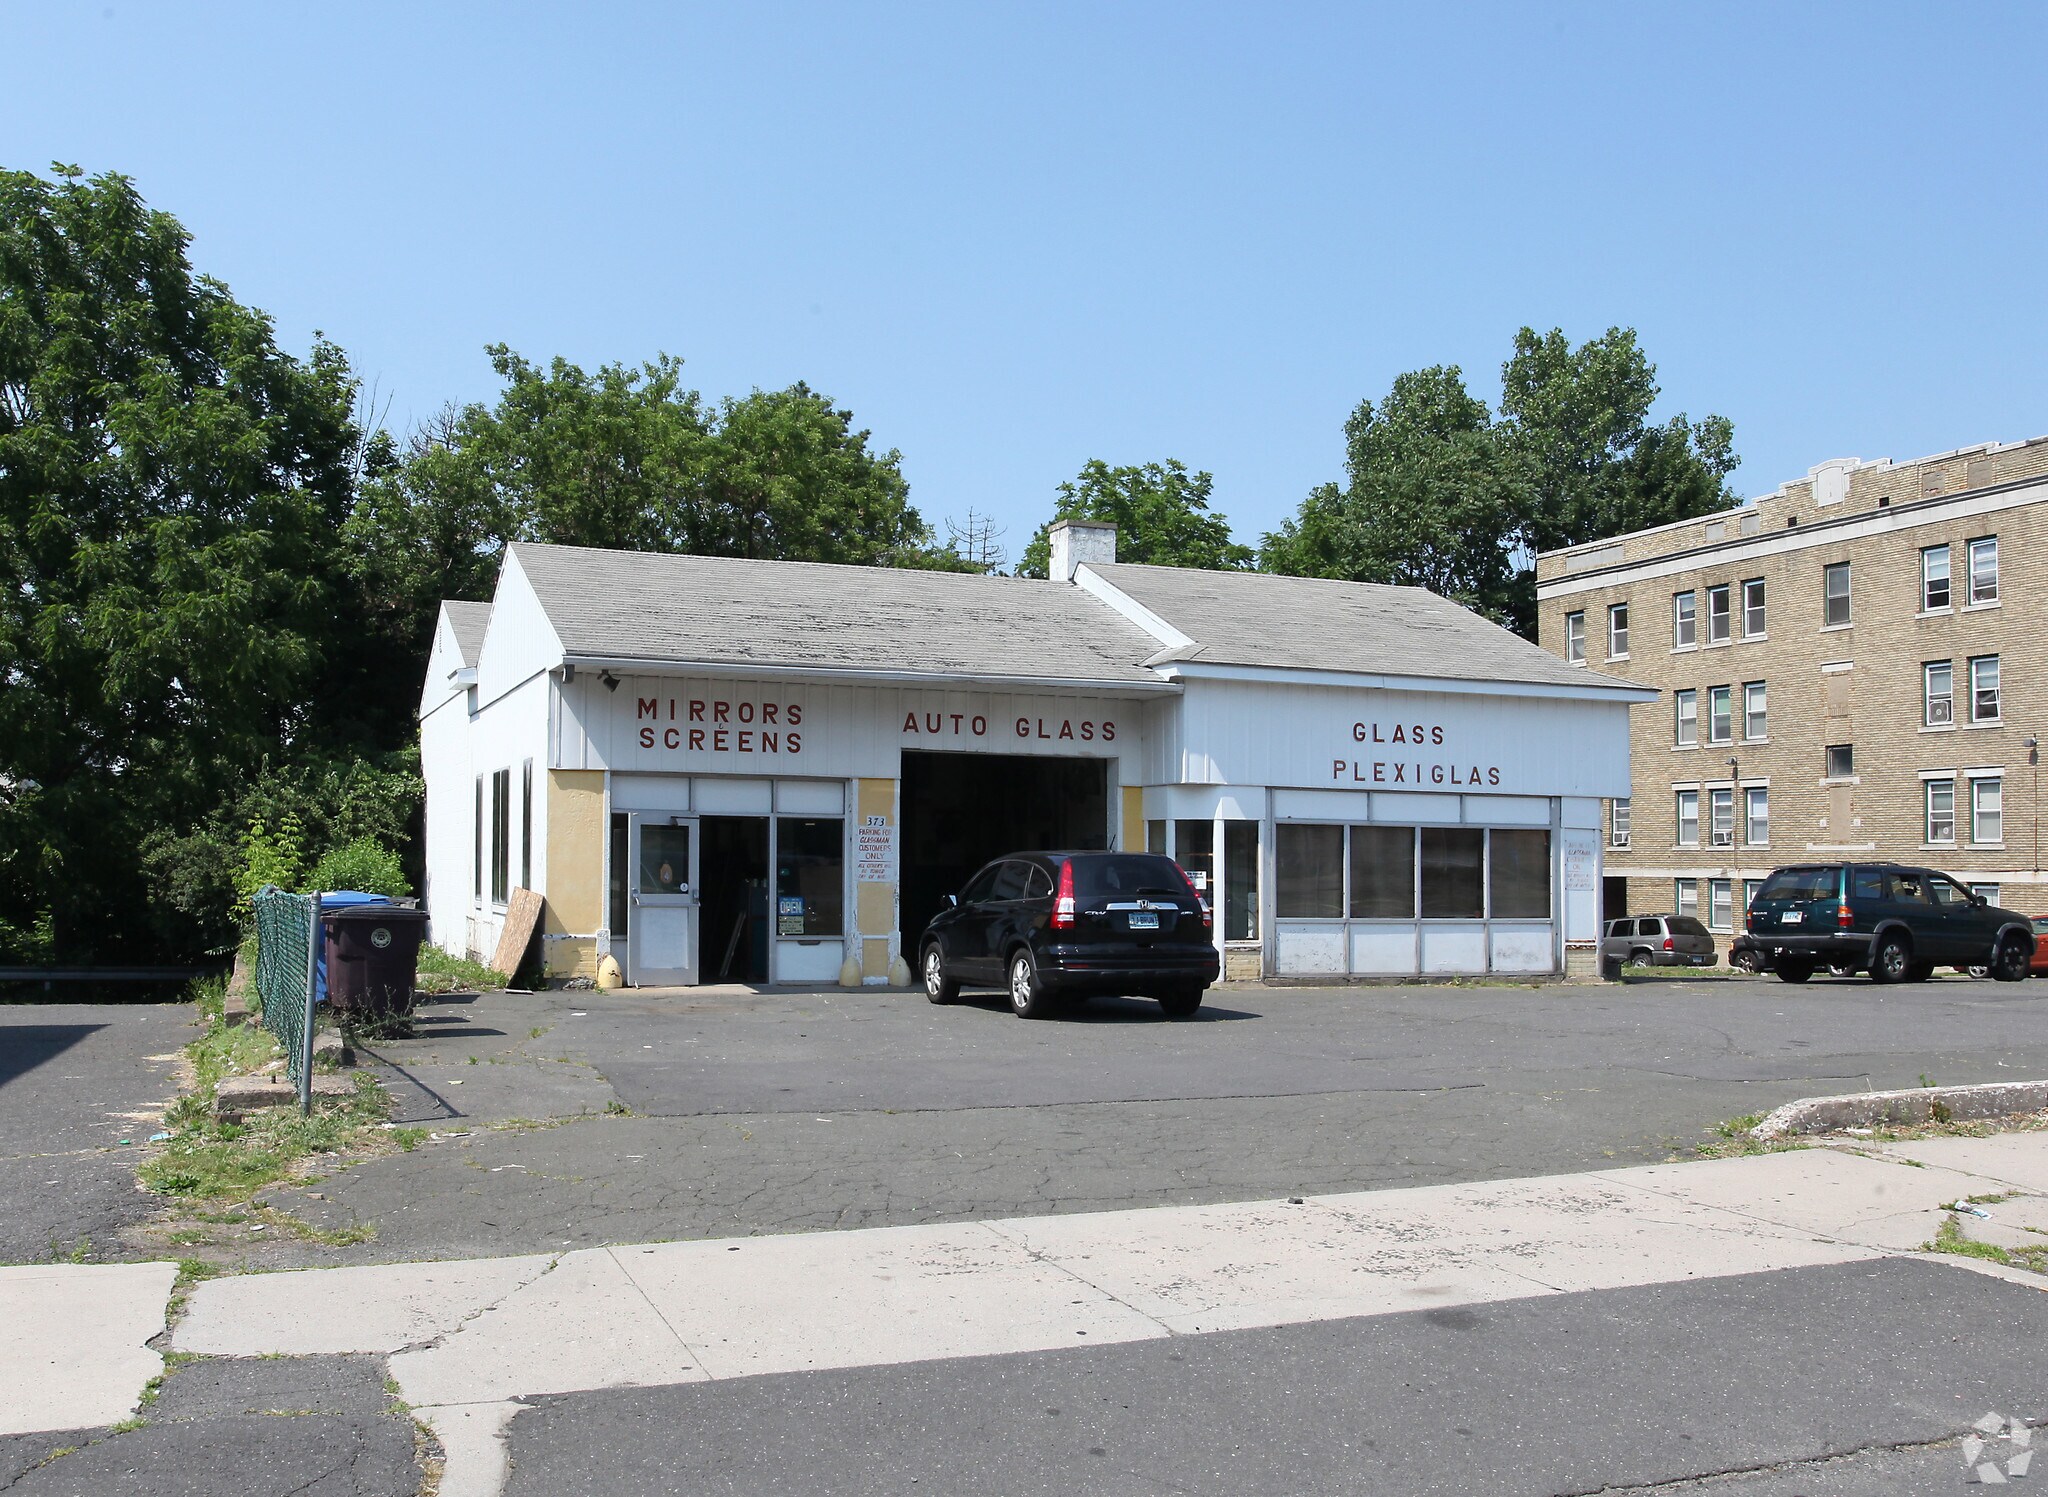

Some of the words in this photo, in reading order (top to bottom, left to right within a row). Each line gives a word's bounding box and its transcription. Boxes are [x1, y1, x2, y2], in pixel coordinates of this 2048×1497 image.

[637, 697, 802, 725] MIRRORS
[902, 712, 987, 736] AUTO
[1015, 717, 1116, 741] GLASS
[1352, 722, 1444, 745] GLASS
[639, 727, 802, 754] SCREENS
[1333, 760, 1501, 786] PLEXIGLAS
[867, 816, 885, 827] 373
[859, 844, 892, 852] CUSTOMERS
[865, 852, 885, 860] ONLY
[780, 901, 802, 914] OPEN
